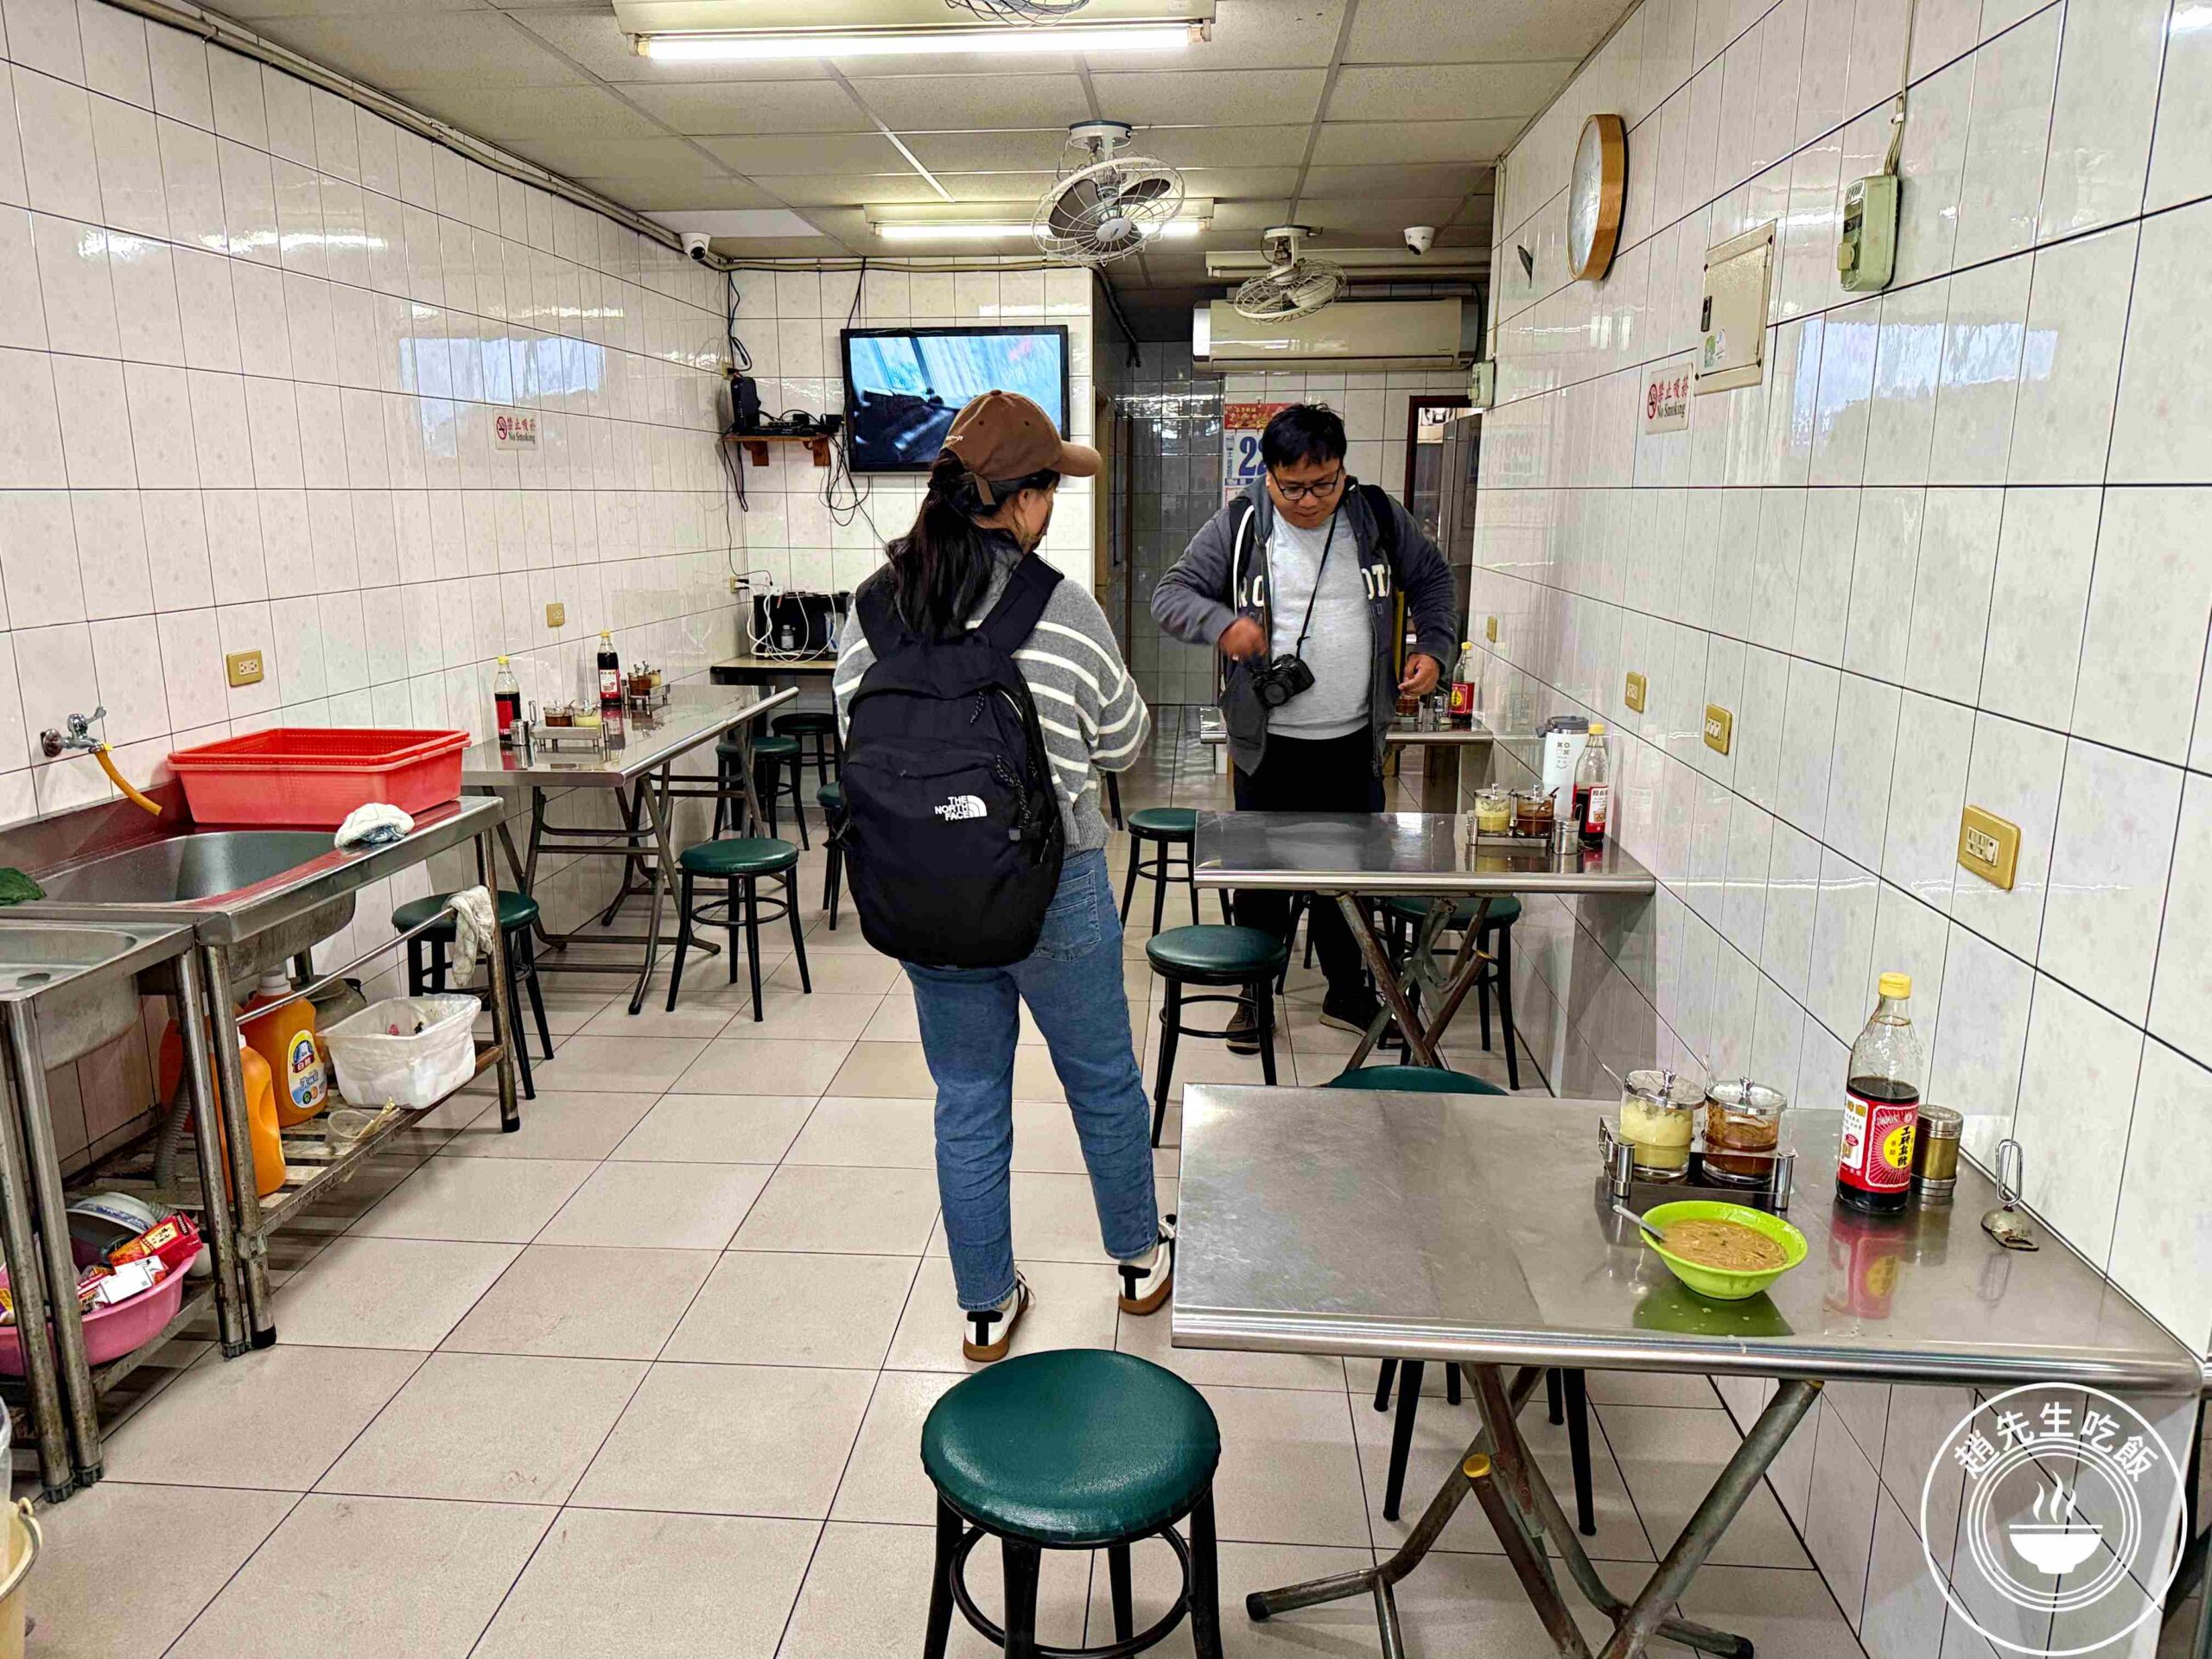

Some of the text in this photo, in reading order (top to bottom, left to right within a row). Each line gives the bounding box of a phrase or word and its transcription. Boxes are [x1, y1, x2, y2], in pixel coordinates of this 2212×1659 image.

[1656, 401, 1686, 419] No Smoking
[508, 431, 536, 444] No Smoking
[947, 795, 968, 805] THE
[934, 803, 969, 815] NORTH
[944, 811, 969, 822] FACE
